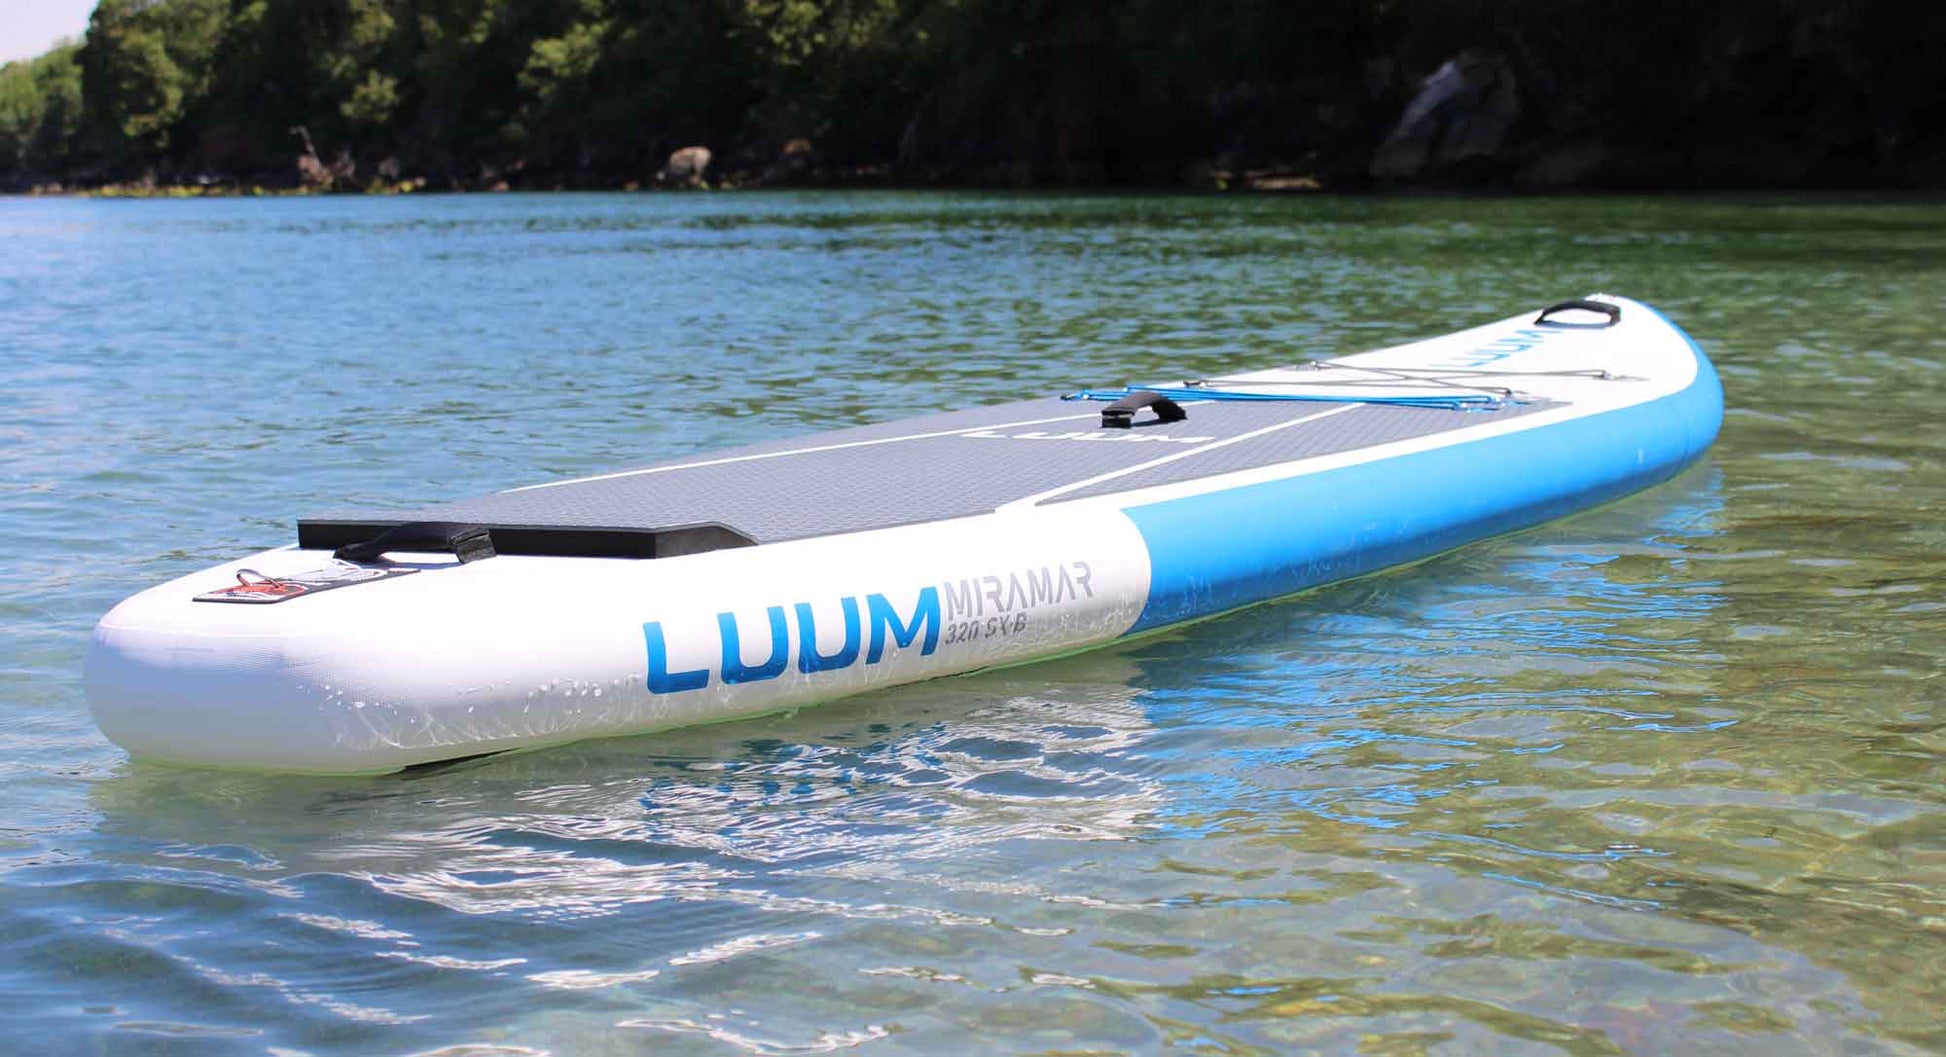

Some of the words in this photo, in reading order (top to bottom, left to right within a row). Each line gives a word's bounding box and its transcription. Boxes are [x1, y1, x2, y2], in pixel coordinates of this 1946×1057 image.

[960, 430, 1216, 444] LUUM
[943, 560, 1094, 621] MIRAMAR
[643, 585, 942, 694] LUUM
[945, 619, 980, 645] 320
